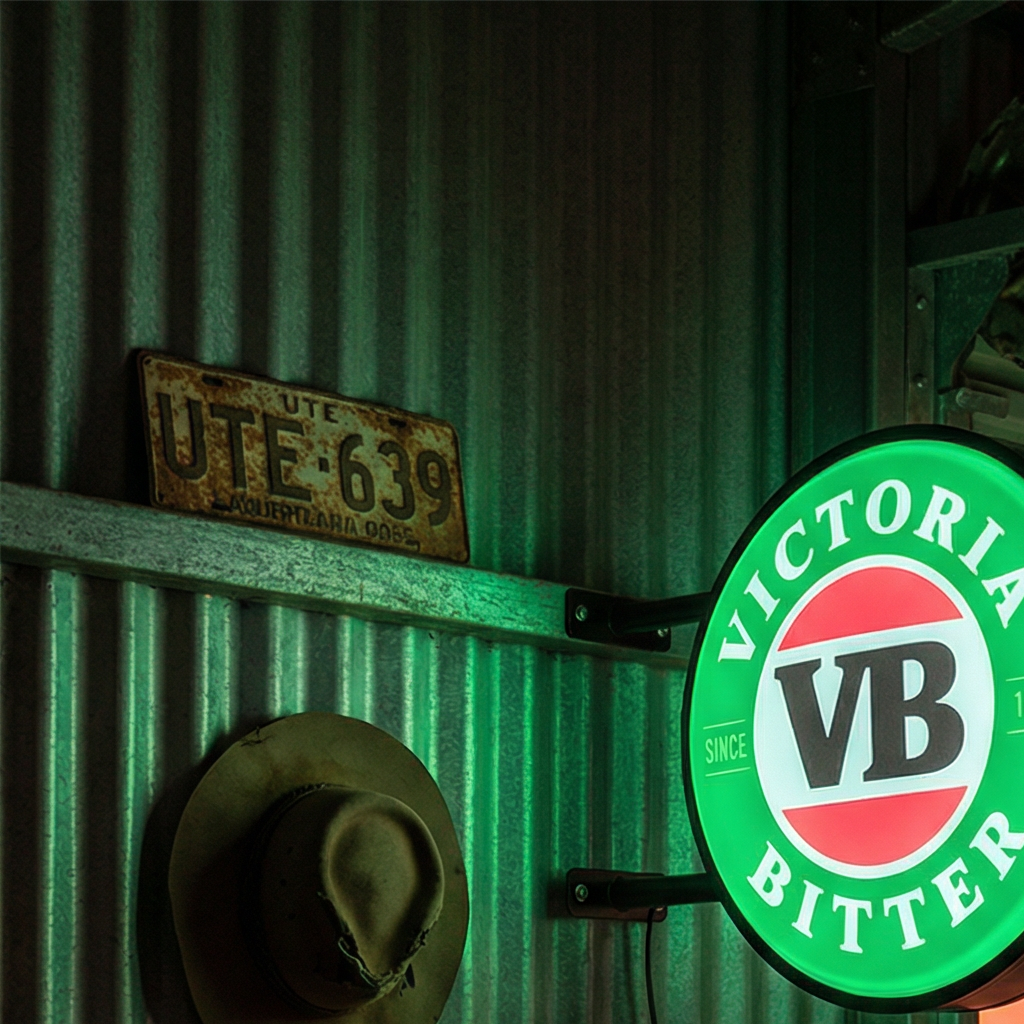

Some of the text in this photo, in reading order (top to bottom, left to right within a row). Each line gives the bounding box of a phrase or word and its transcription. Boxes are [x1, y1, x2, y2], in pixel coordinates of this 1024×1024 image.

[282, 393, 340, 424] UTE
[774, 640, 966, 790] VB
[704, 732, 748, 765] SINCE
